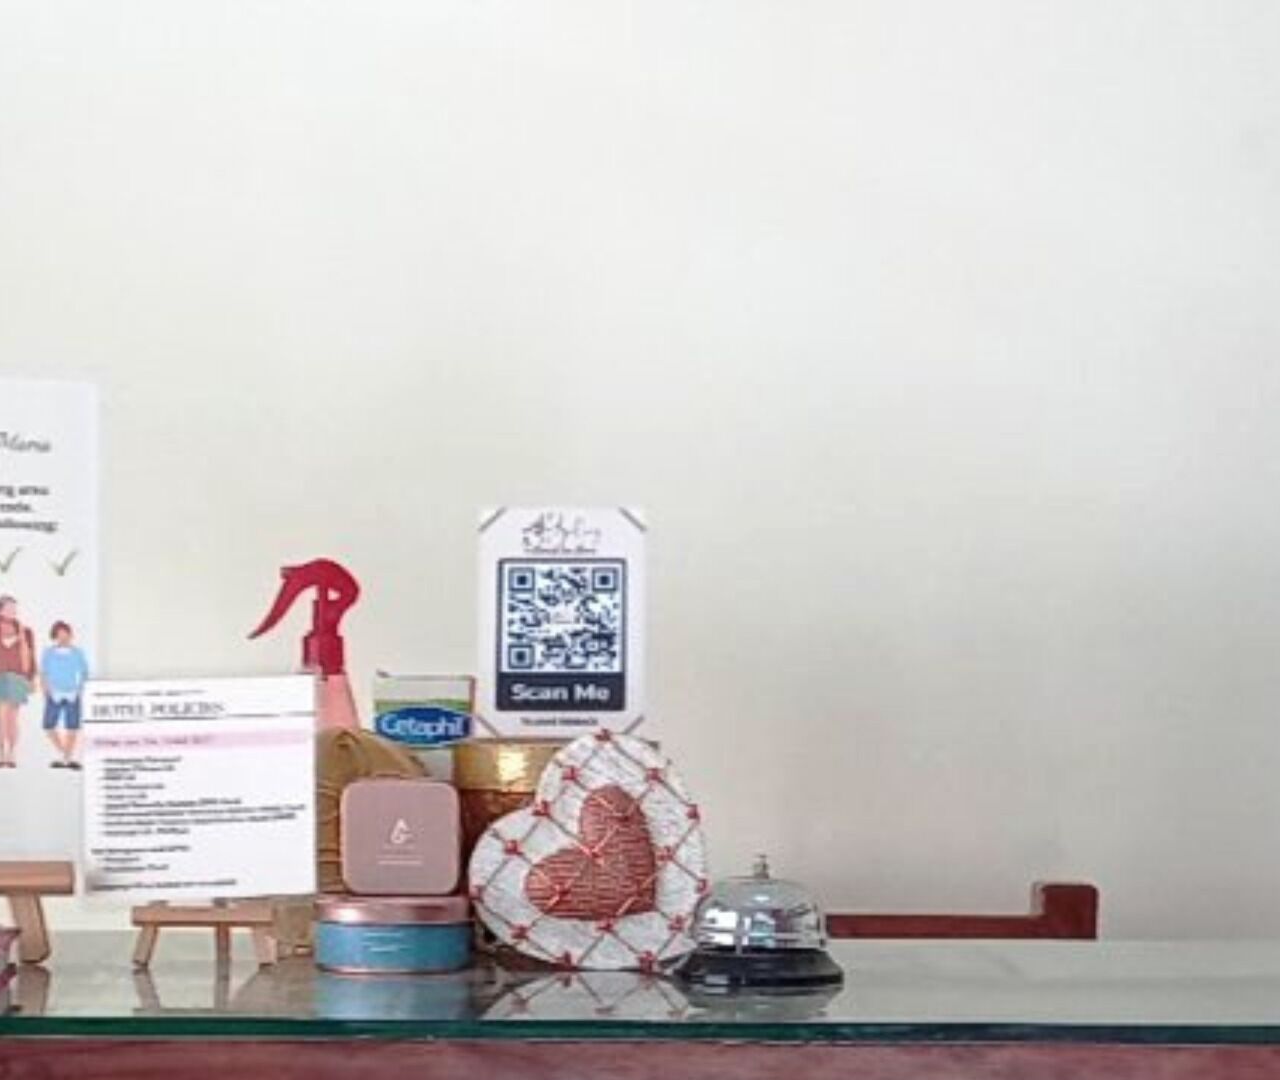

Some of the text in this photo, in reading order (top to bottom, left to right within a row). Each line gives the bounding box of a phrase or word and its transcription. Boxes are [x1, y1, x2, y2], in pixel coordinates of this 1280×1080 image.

[511, 683, 610, 701] Scan Me
[381, 713, 464, 738] Cetaphil
